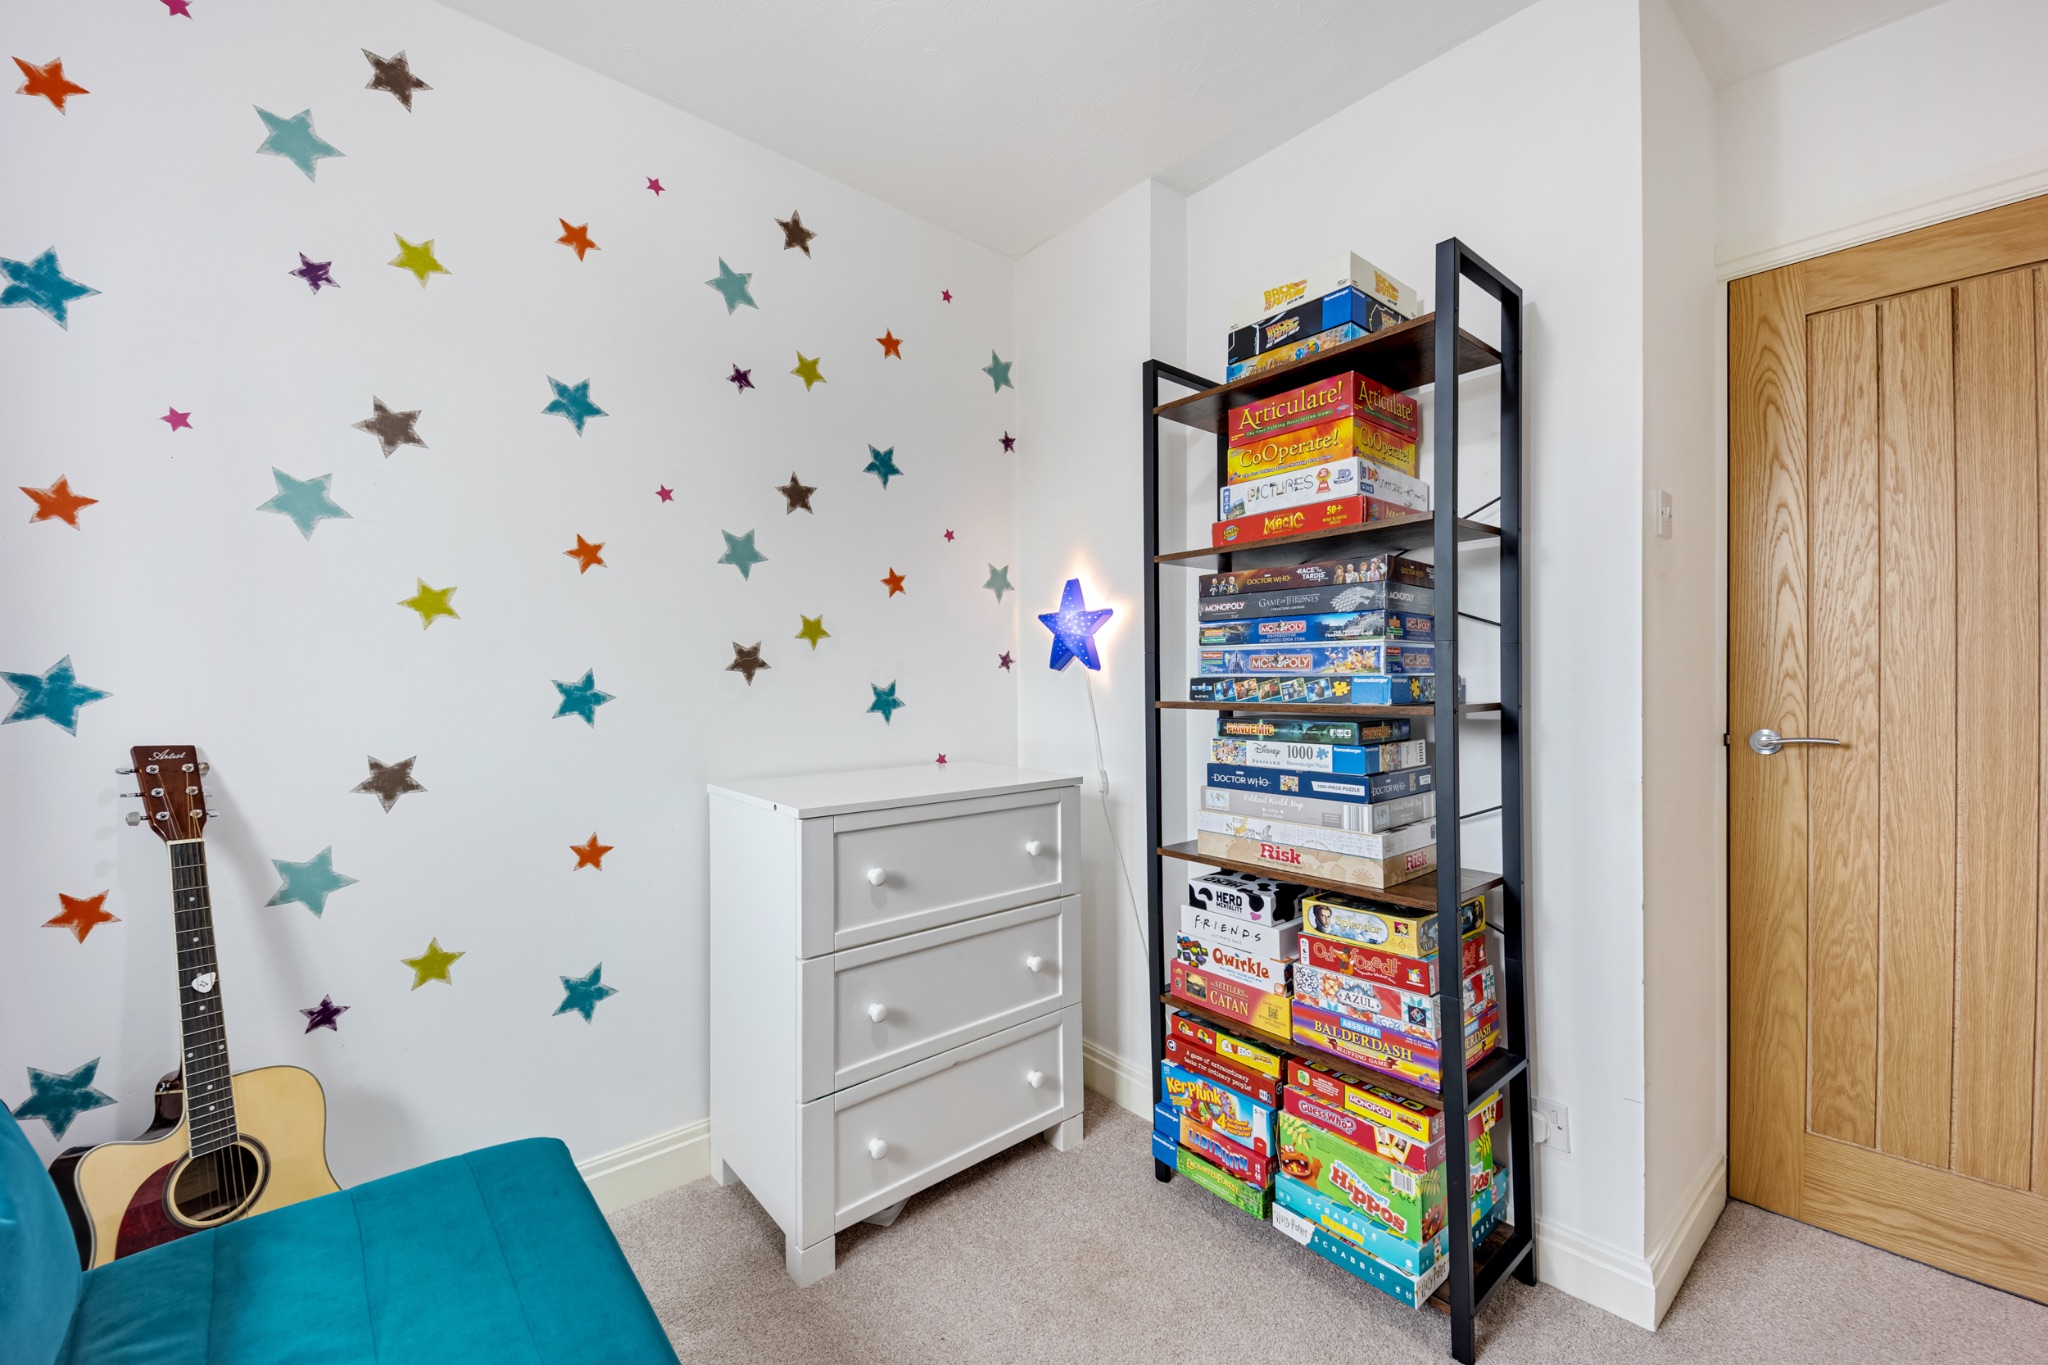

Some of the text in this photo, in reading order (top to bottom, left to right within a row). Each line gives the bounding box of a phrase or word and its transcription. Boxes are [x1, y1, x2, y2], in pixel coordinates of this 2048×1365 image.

[1264, 282, 1295, 302] BACK
[1239, 381, 1343, 430] Articulate!
[1358, 380, 1413, 421] Articulate!
[1240, 428, 1338, 468] CoOperate!
[1361, 427, 1410, 464] CoOperate!
[1247, 474, 1314, 502] PICTURES
[1326, 504, 1343, 515] 50+
[1263, 511, 1305, 535] MAGIC
[1246, 575, 1292, 586] DOCTOR WHO
[1302, 572, 1326, 582] TARDIS
[1258, 599, 1280, 608] GAME
[1285, 594, 1320, 606] THRONES
[1389, 591, 1414, 602] MONOPOLY
[1205, 602, 1245, 612] MONOPOLY
[1261, 621, 1304, 632] MONOPOLY
[1252, 657, 1309, 669] MONOPOLY
[1226, 723, 1275, 736] PANDEMIC
[1362, 726, 1391, 740] PANDEMIC
[148, 749, 186, 761] Artist
[1253, 743, 1281, 757] Disney
[1287, 745, 1314, 760] 1000
[1211, 773, 1271, 787] DOCTOR WHO
[1371, 782, 1406, 797] DOCTOR WHO
[1244, 794, 1304, 812] Political World Map
[1260, 843, 1301, 865] Risk
[1405, 851, 1428, 873] Risk
[1215, 891, 1243, 907] HERD
[1216, 902, 1243, 913] MENTALITY
[1334, 915, 1381, 934] Splendor
[1212, 947, 1270, 979] Qwirkle
[1313, 942, 1398, 977] Out foxed!
[1215, 981, 1245, 996] SETTLERS
[1210, 990, 1249, 1017] CATAN
[1344, 992, 1374, 1010] AZUL
[1342, 1019, 1379, 1037] ABSOLUTE
[1221, 1039, 1252, 1057] CLUEDO
[1314, 1020, 1413, 1062] BALDERDASH
[1336, 1045, 1367, 1062] BLUFFING
[1369, 1057, 1388, 1068] GAME
[1184, 1057, 1252, 1092] tasks for ordinary people!
[1191, 1053, 1203, 1061] game
[1211, 1061, 1250, 1083] extraordinary
[1166, 1076, 1222, 1105] KerPlunk
[1348, 1094, 1392, 1118] MONOPOLY
[1217, 1112, 1226, 1130] 4
[1188, 1129, 1249, 1172] LABYRINTH
[1186, 1158, 1219, 1181] ENCHANTED
[1217, 1174, 1239, 1194] FOREST
[1336, 1161, 1388, 1205] Hungry Hungry
[1275, 1210, 1308, 1239] Harry Potter
[1307, 1198, 1378, 1241] SCRABBLE
[1314, 1236, 1386, 1281] SCRABBLE
[1418, 1262, 1447, 1298] Harry Potter
